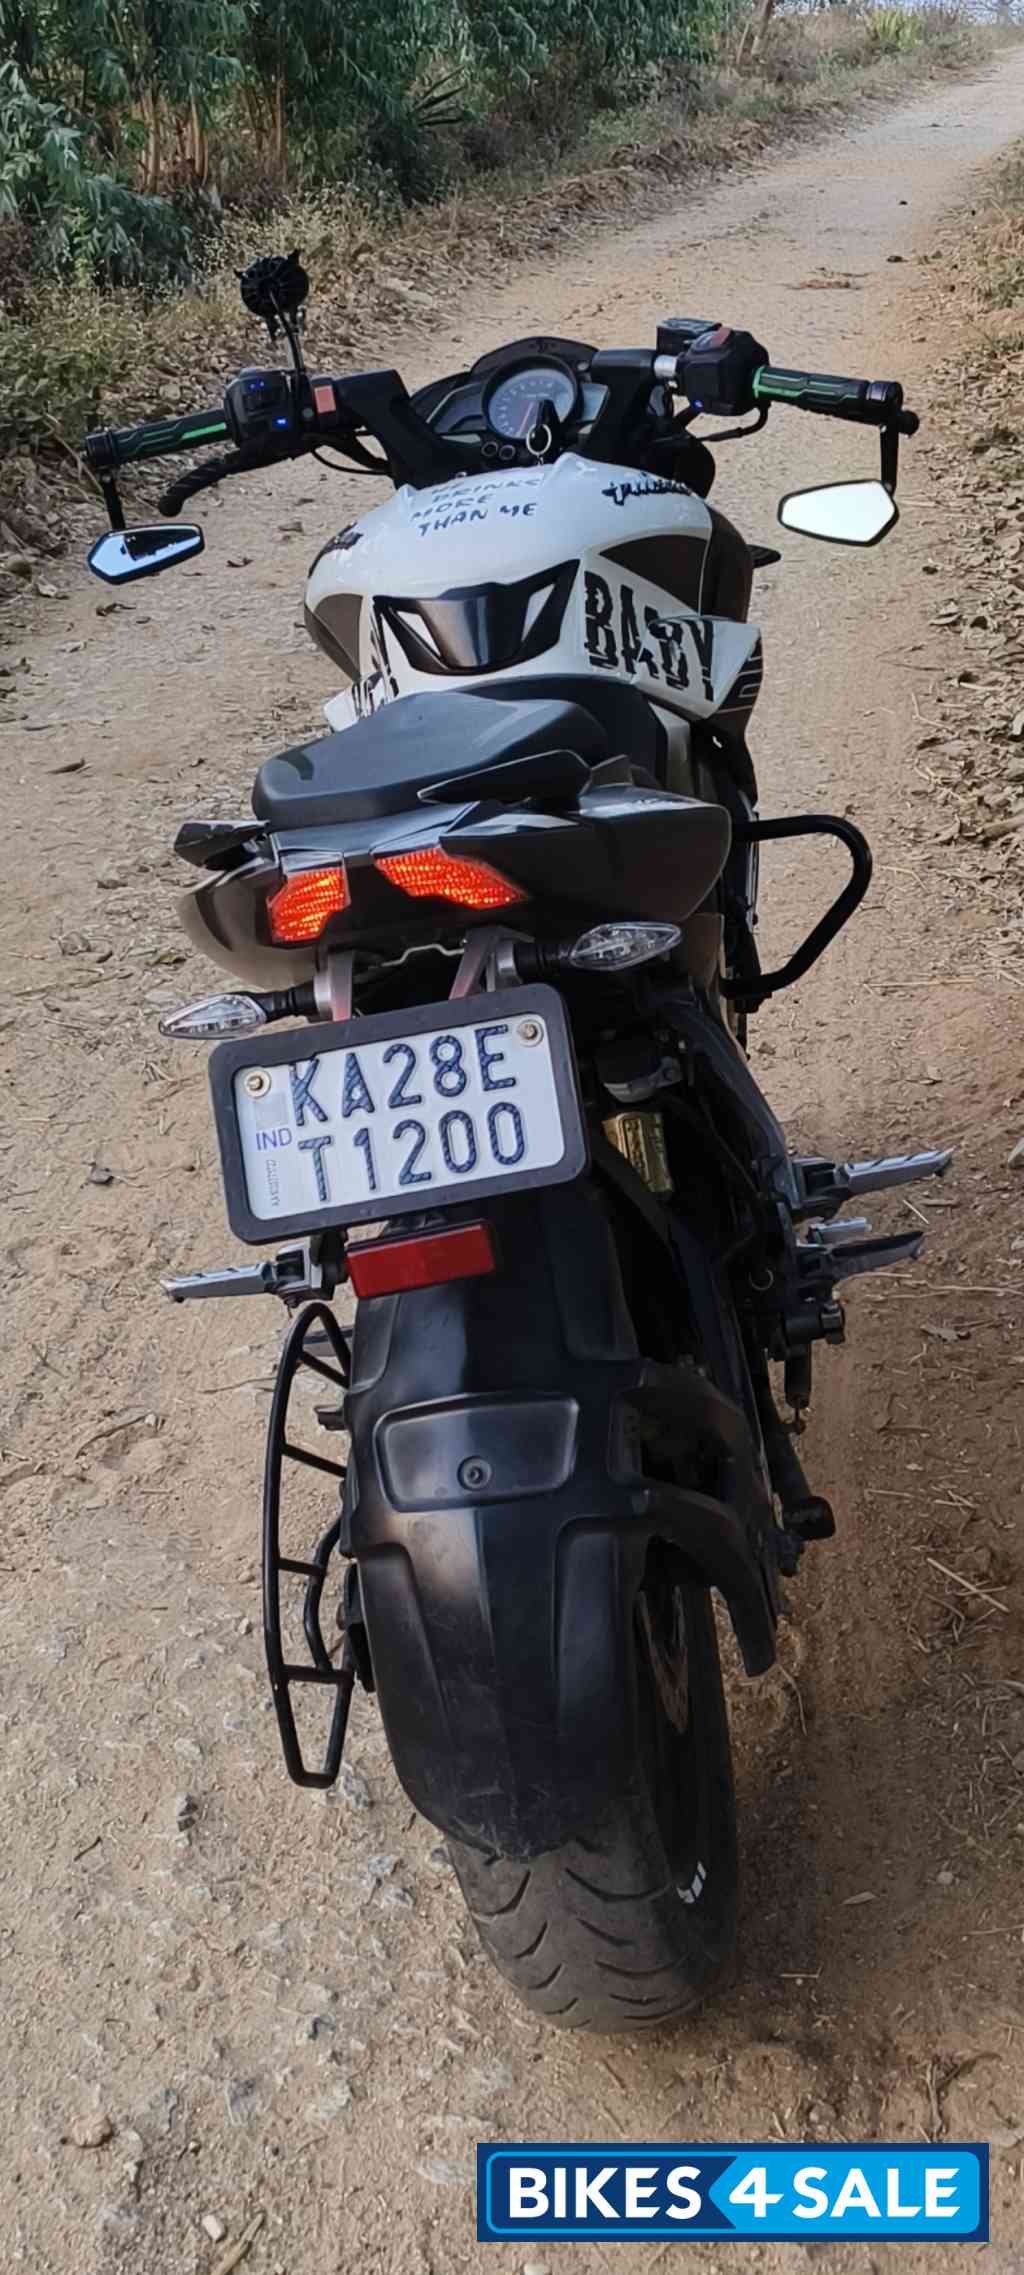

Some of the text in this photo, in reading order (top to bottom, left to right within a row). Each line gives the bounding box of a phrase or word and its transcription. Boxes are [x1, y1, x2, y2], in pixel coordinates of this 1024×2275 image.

[418, 502, 537, 537] THAN ME
[584, 570, 715, 702] BABY
[288, 1024, 517, 1127] KA28E
[255, 1127, 293, 1151] IND
[298, 1101, 526, 1203] T1200
